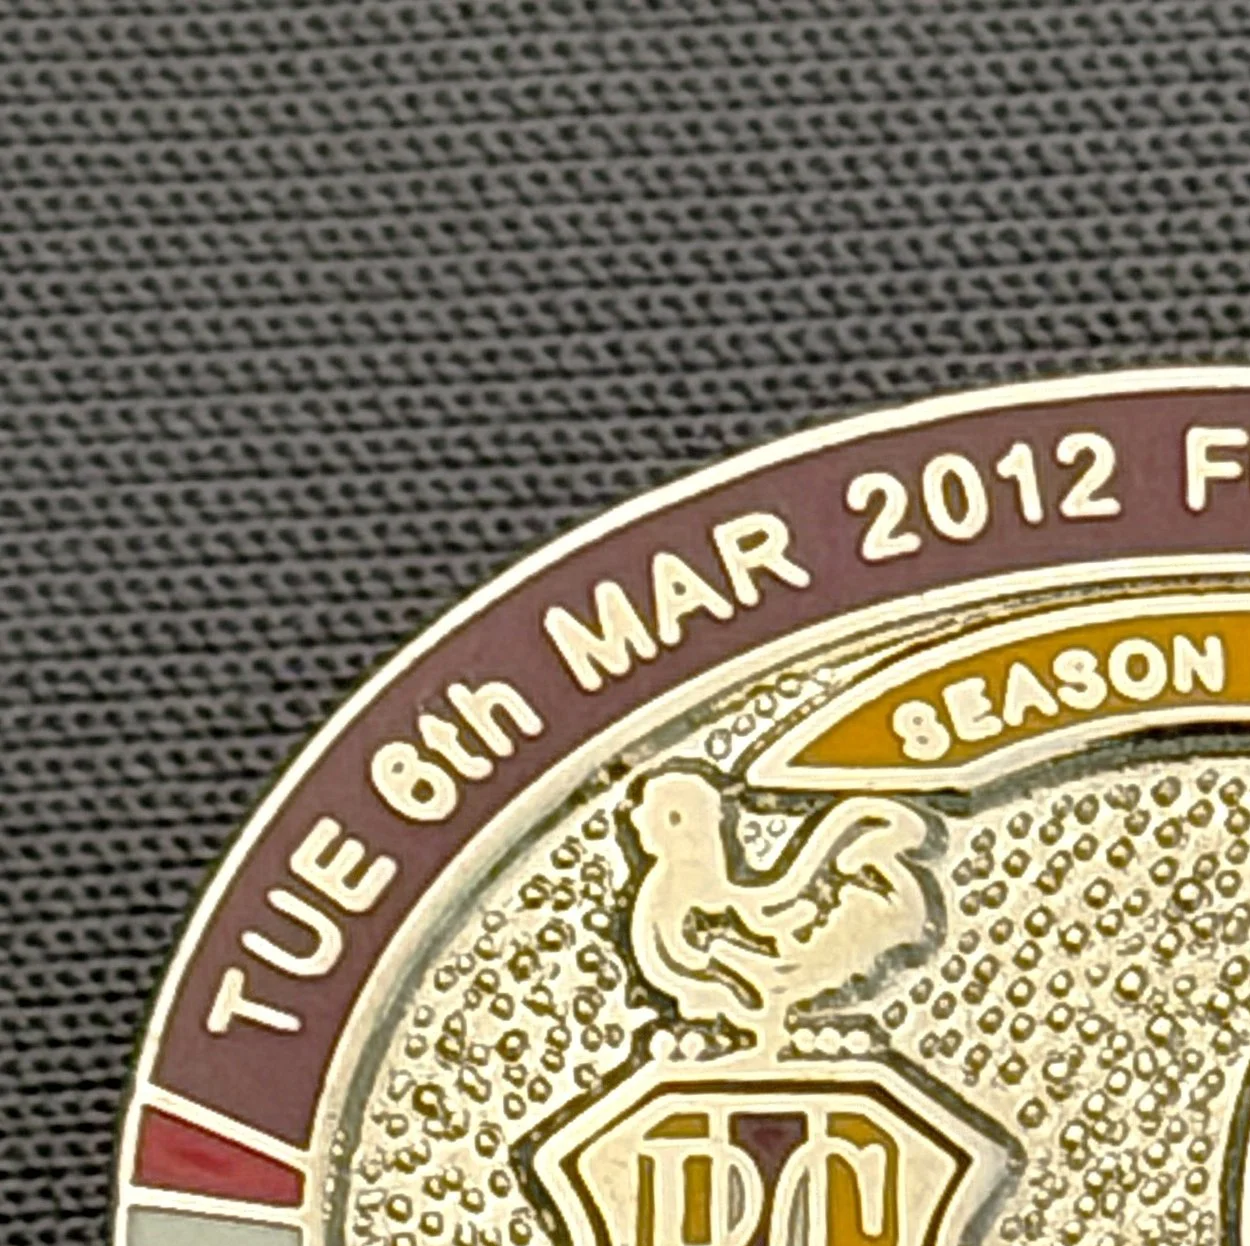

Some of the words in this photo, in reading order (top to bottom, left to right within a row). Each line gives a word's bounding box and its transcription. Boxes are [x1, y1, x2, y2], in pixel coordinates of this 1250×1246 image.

[205, 817, 397, 1034] TUE
[371, 681, 544, 822] 6th
[544, 512, 810, 692] MAR
[847, 432, 1121, 559] 2012
[892, 635, 1225, 761] SEASON
